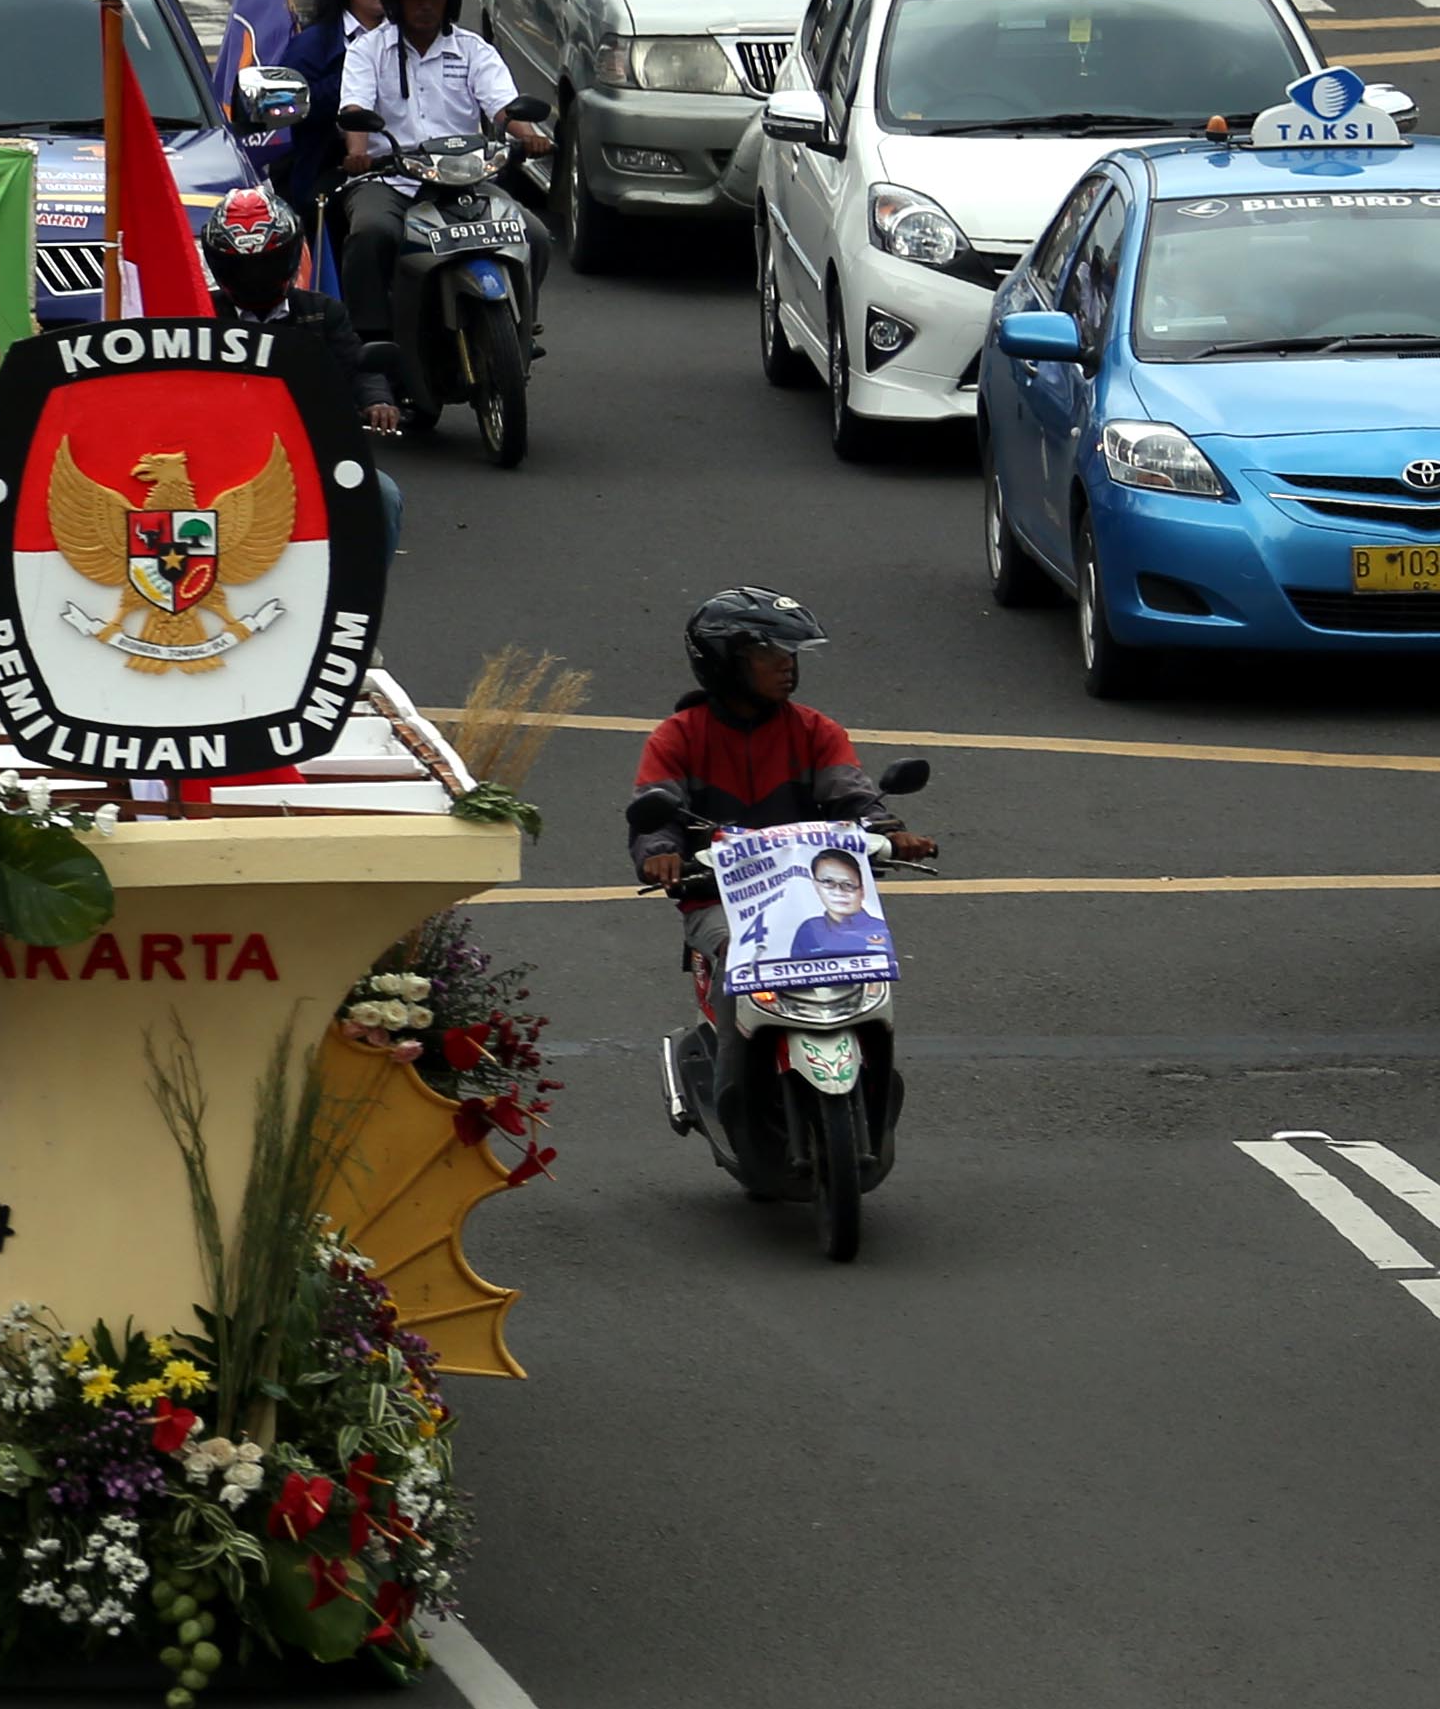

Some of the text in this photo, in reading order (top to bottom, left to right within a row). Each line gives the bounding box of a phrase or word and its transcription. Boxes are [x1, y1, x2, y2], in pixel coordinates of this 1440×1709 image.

[1277, 123, 1374, 141] TAKSI
[1242, 197, 1325, 212] BLUE
[1332, 195, 1412, 208] BIRD
[431, 230, 442, 244] B
[451, 224, 487, 239] 6913
[57, 326, 276, 375] KOMISI
[1356, 551, 1370, 578] B
[268, 611, 371, 757] UMUM
[717, 833, 789, 868] CALEG
[722, 856, 776, 886] CALEGNYA
[740, 911, 769, 947] 4
[772, 960, 845, 977] SIYONO,
[849, 957, 872, 969] SE
